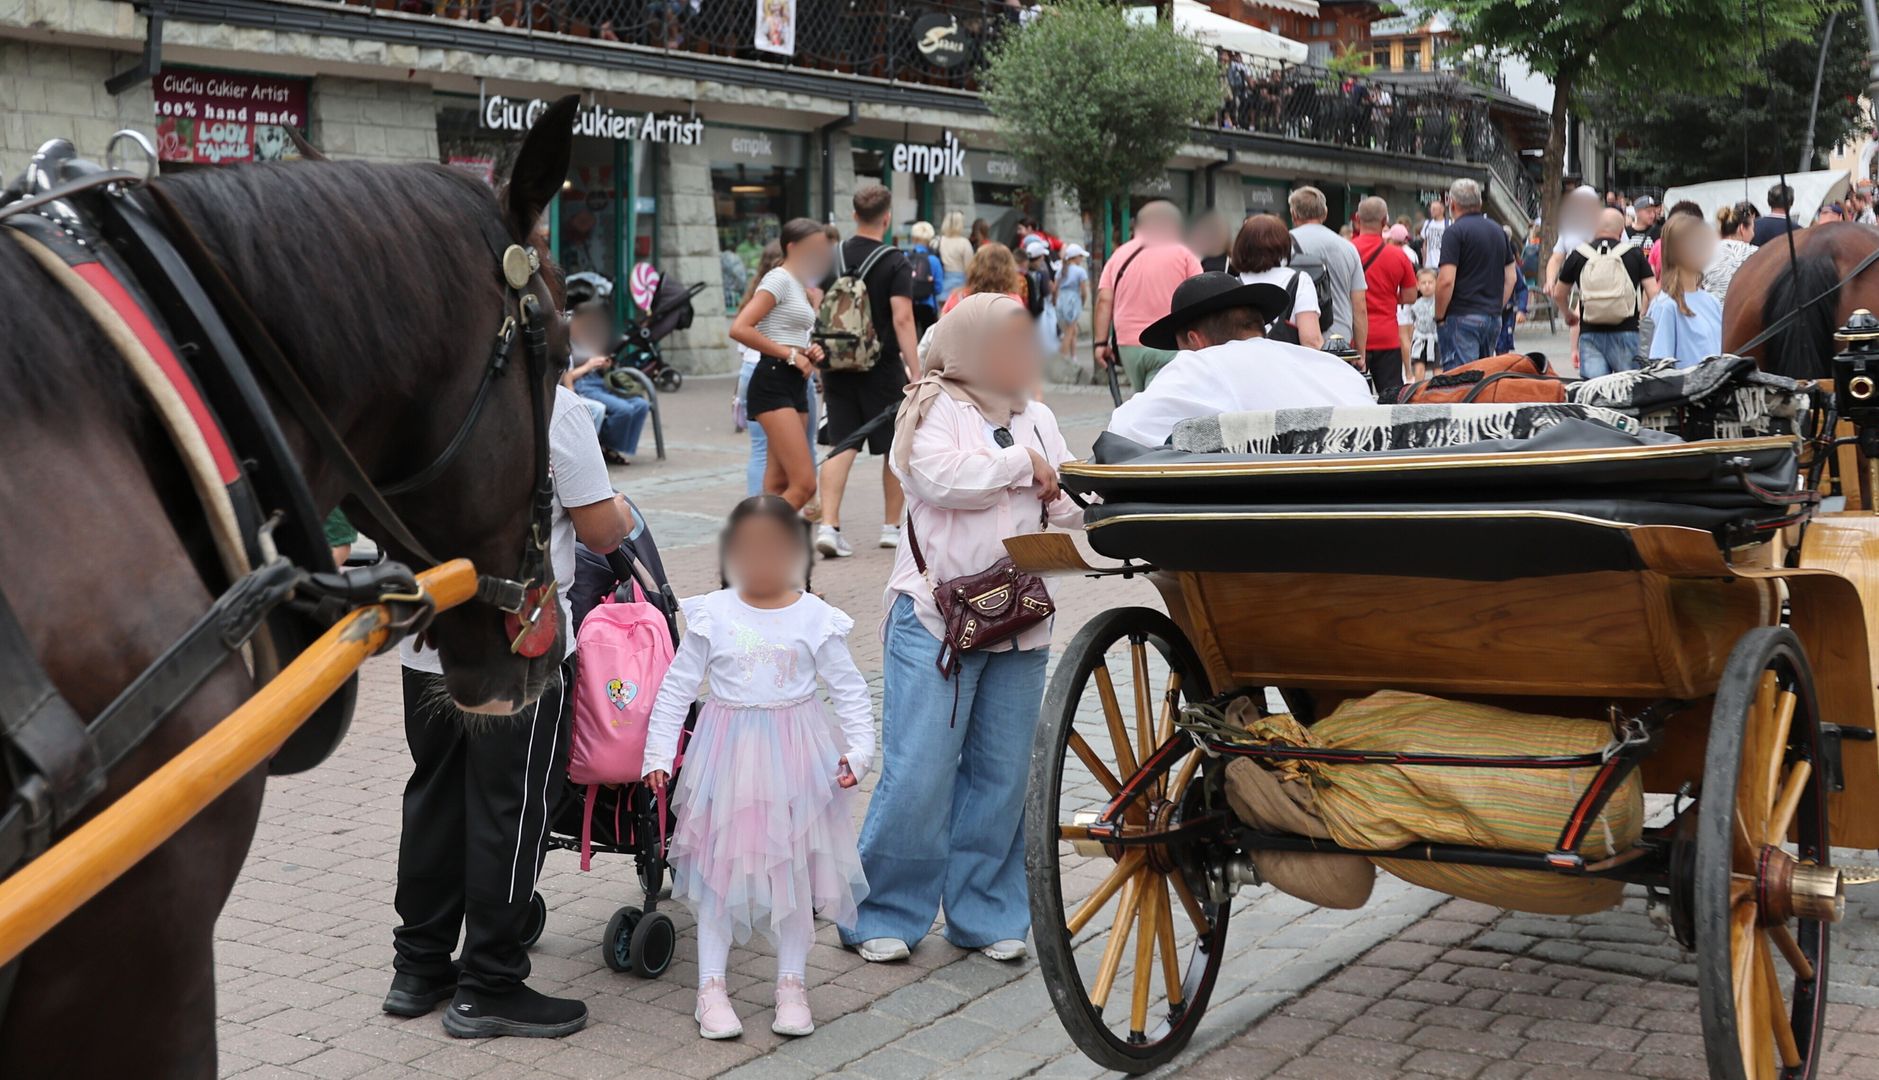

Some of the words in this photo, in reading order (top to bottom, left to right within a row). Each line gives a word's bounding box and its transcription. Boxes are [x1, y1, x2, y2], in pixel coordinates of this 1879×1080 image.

[163, 74, 204, 96] CiuCiu
[206, 79, 248, 99] Cukier
[251, 83, 290, 103] Artist
[154, 101, 197, 117] 100%
[205, 103, 248, 122] hand
[254, 109, 299, 126] made
[486, 94, 522, 131] Ciu
[571, 103, 637, 140] ukier
[641, 111, 705, 145] Artist
[198, 121, 249, 144] LODY
[731, 132, 772, 157] empik
[892, 130, 966, 183] empik
